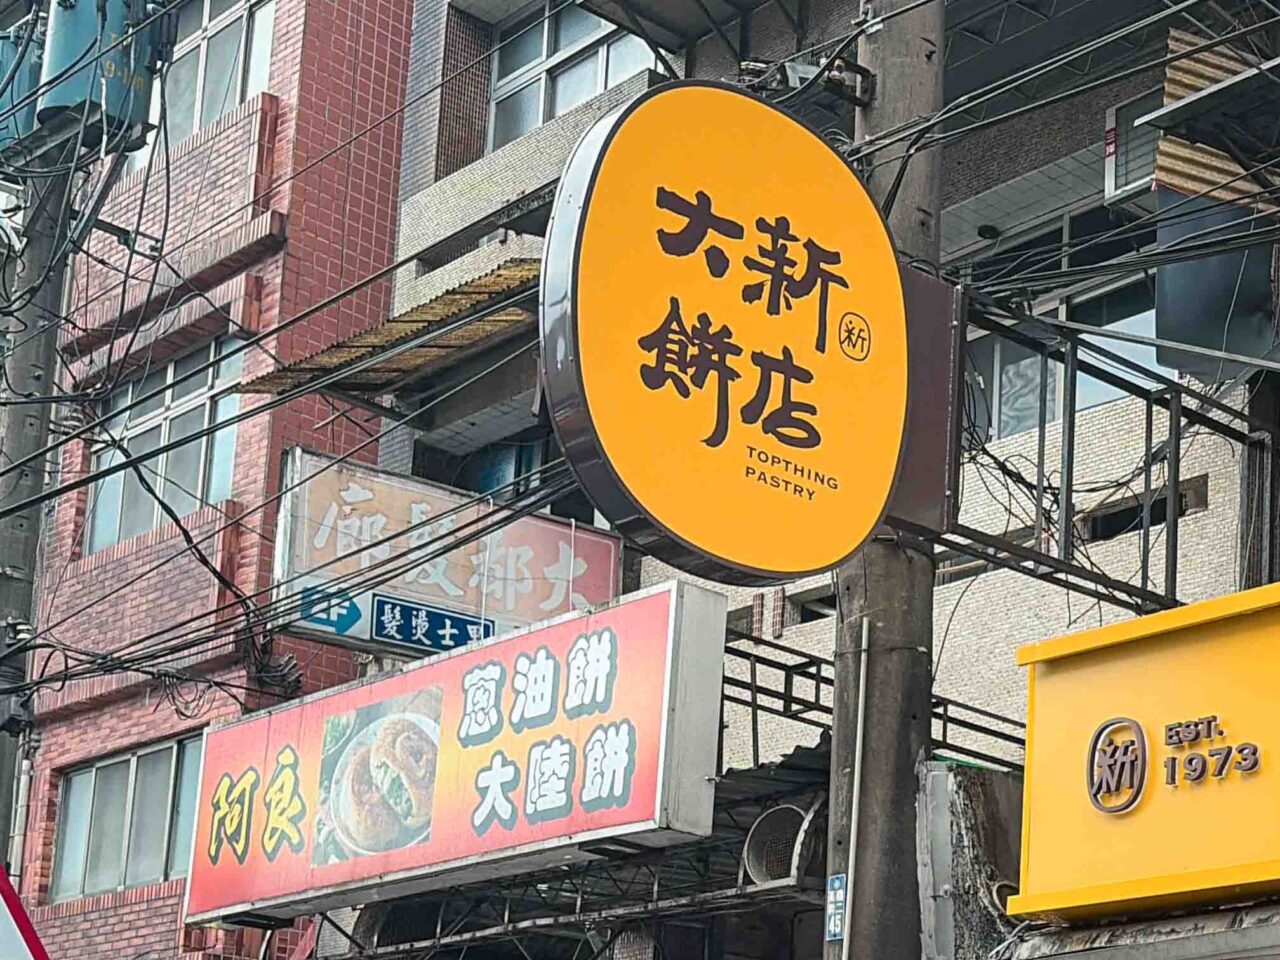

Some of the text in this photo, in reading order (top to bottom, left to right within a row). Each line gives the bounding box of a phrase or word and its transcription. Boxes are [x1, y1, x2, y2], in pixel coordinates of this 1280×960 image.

[656, 186, 849, 354] 大新
[638, 296, 821, 448] 餅店
[745, 467, 816, 501] PASTRY
[746, 446, 838, 490] TOPTHING
[1164, 743, 1261, 785] 1973
[1165, 715, 1225, 746] EST.
[208, 745, 308, 865] 阿良
[473, 720, 635, 834] 大陸餅
